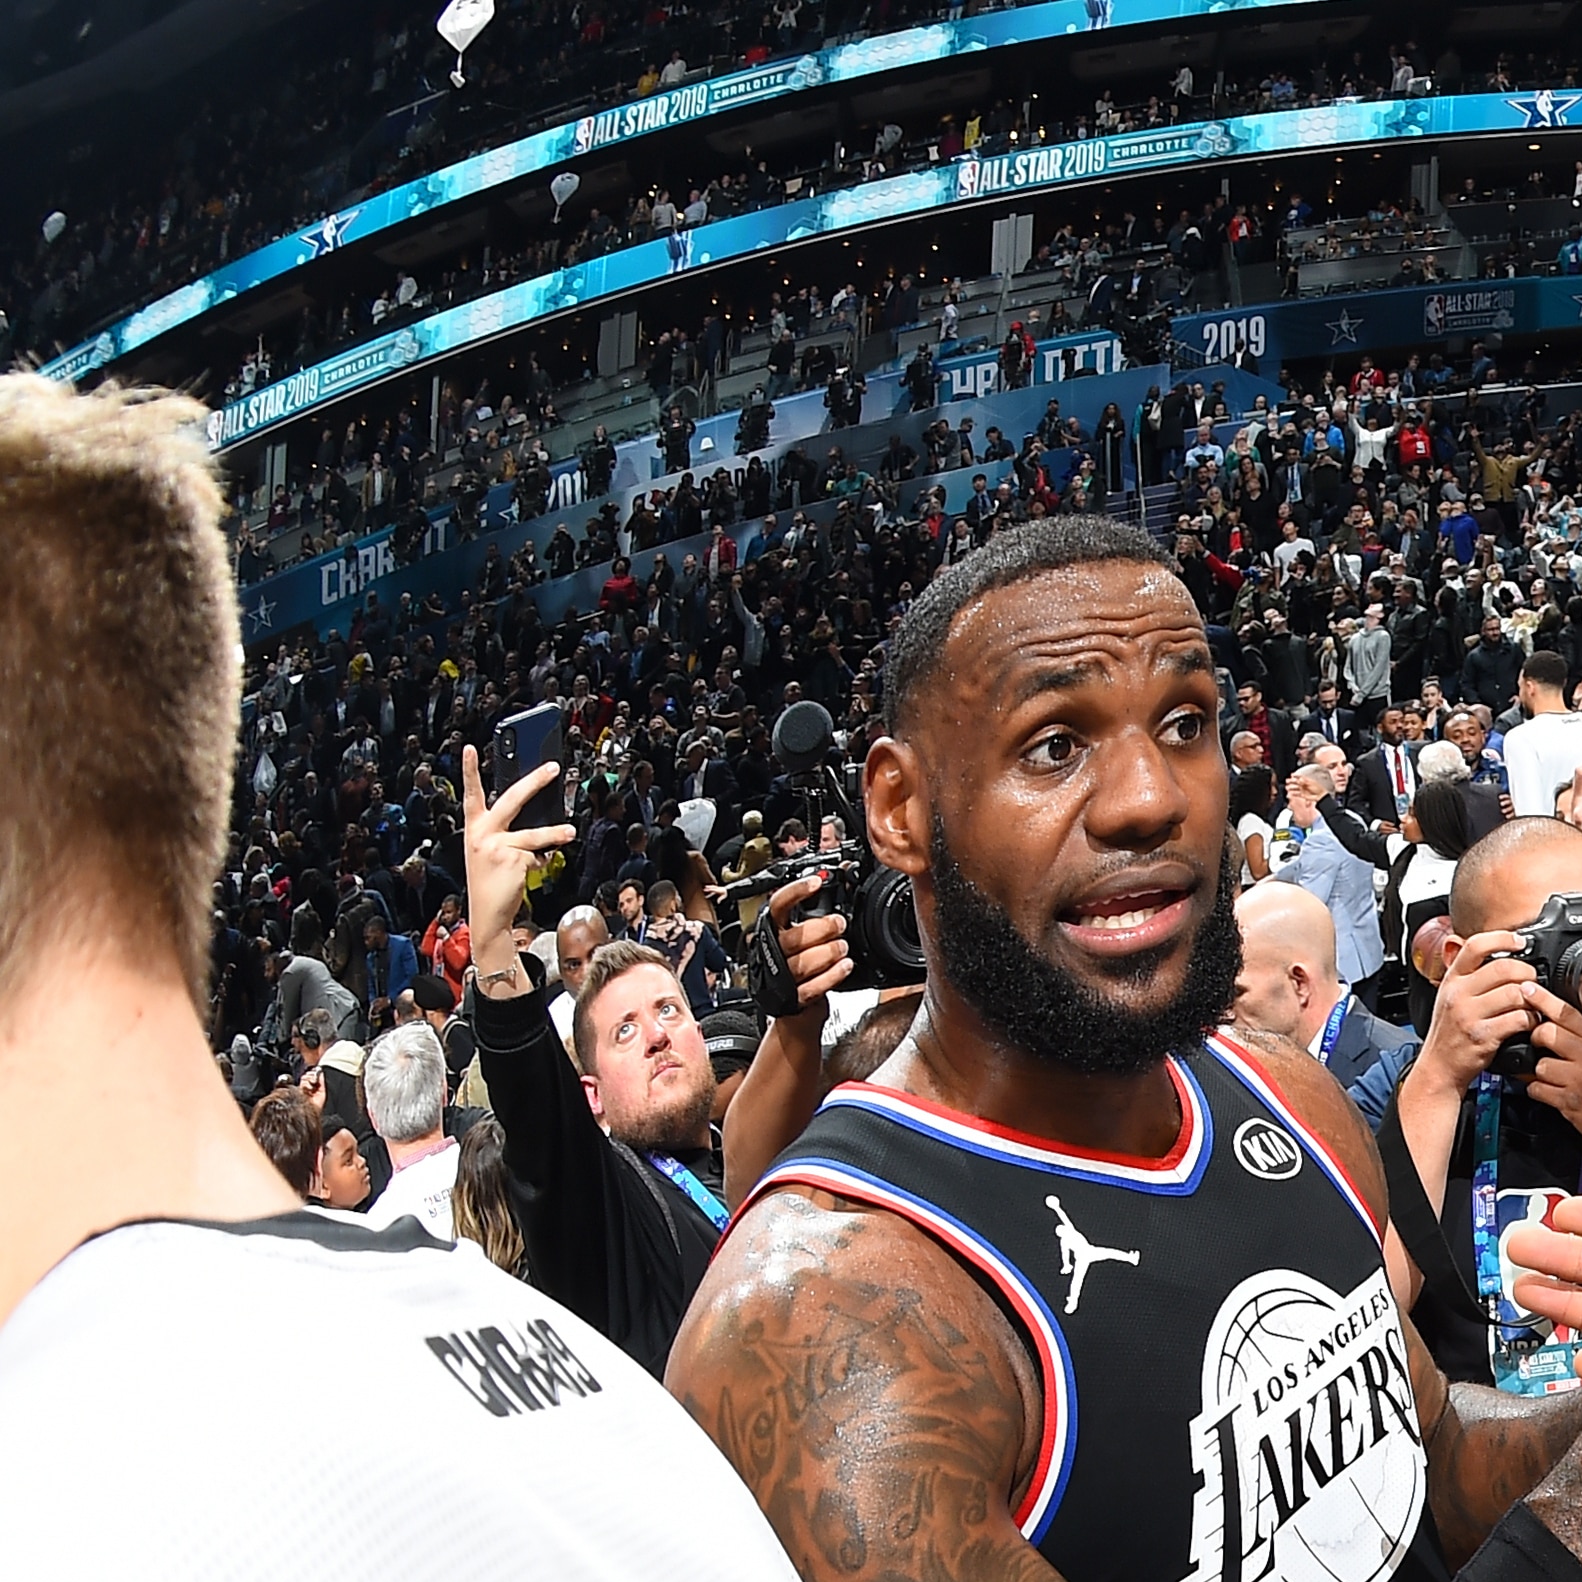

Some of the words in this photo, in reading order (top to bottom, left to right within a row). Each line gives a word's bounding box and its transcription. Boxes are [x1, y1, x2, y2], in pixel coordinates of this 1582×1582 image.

[669, 84, 708, 123] 2019
[713, 73, 783, 100] CHARLOTTE
[1064, 141, 1105, 180] 2019
[1113, 139, 1188, 159] CHARLOTTE
[1203, 316, 1266, 364] 2019
[324, 352, 384, 384] CHARLOTTE
[287, 368, 319, 410] 2019
[1241, 1130, 1297, 1171] KIA
[1252, 1363, 1298, 1417] LOS
[1304, 1287, 1391, 1377] ANGELES
